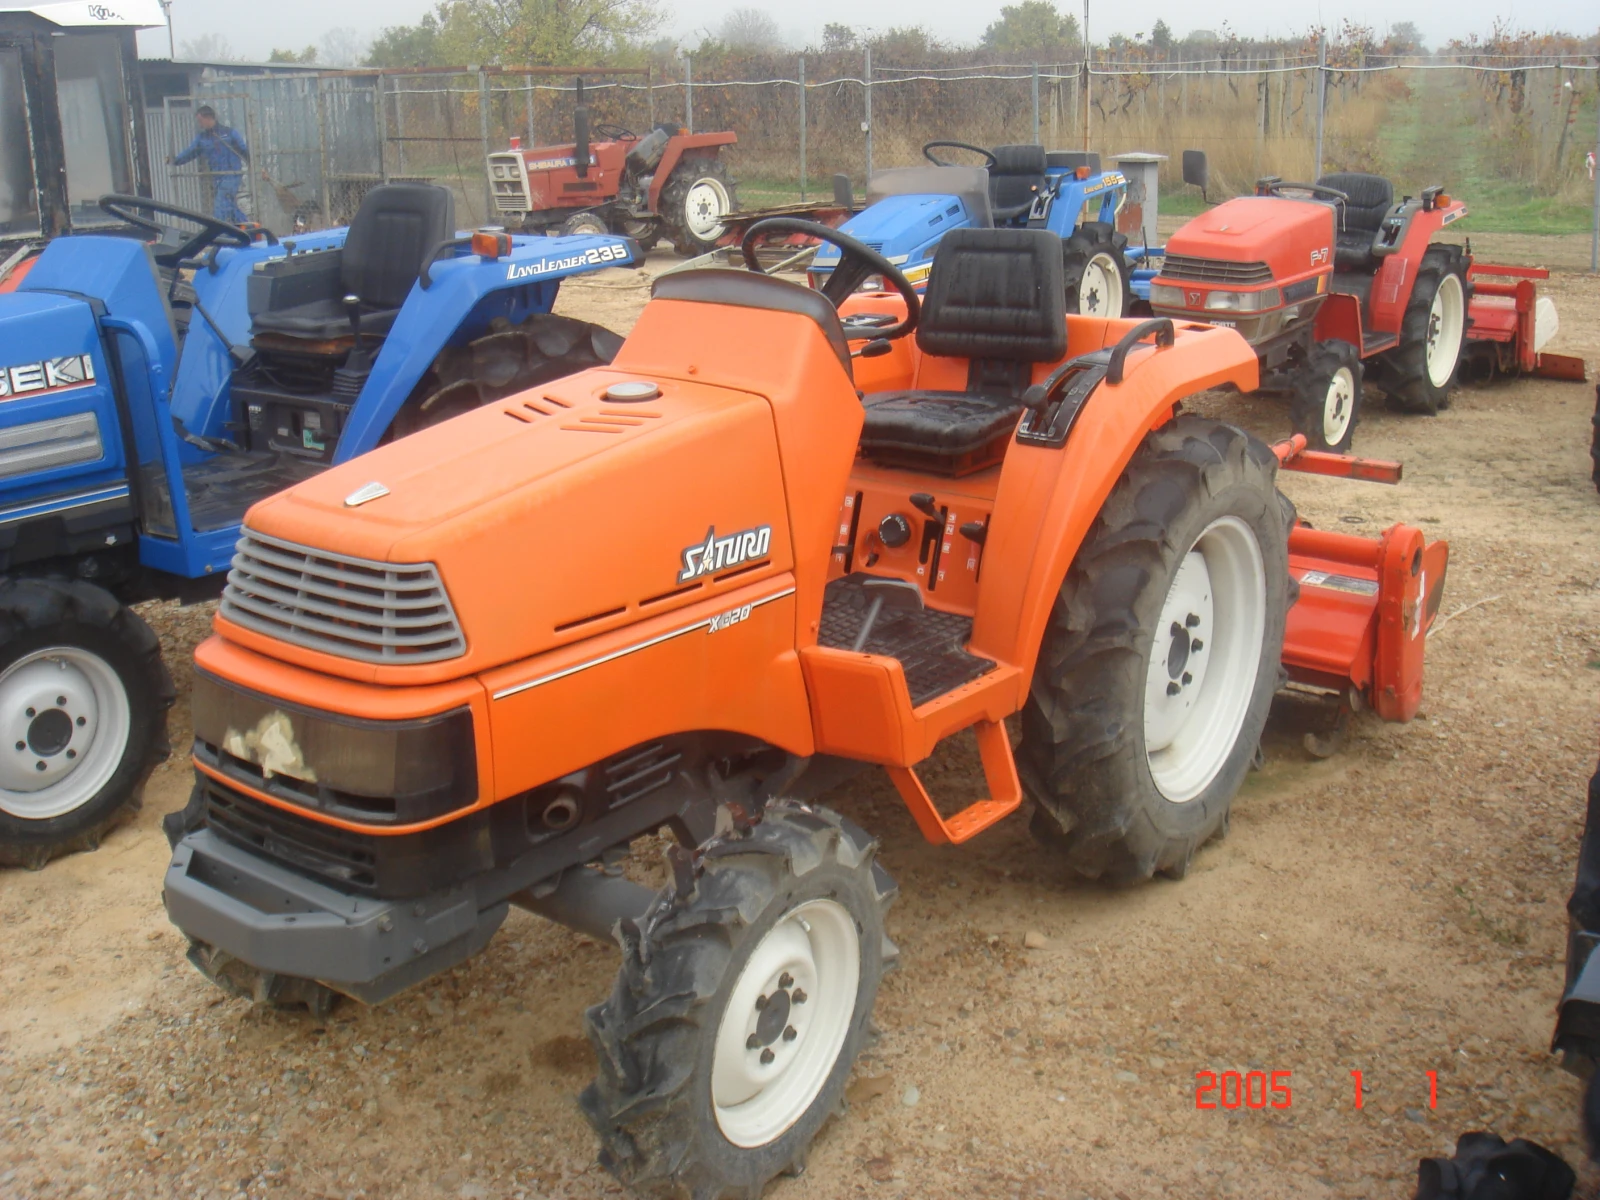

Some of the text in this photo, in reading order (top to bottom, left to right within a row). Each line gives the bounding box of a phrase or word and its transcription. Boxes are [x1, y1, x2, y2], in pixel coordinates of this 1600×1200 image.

[584, 244, 627, 265] 235
[0, 354, 95, 397] EKI
[679, 527, 771, 583] SATURN
